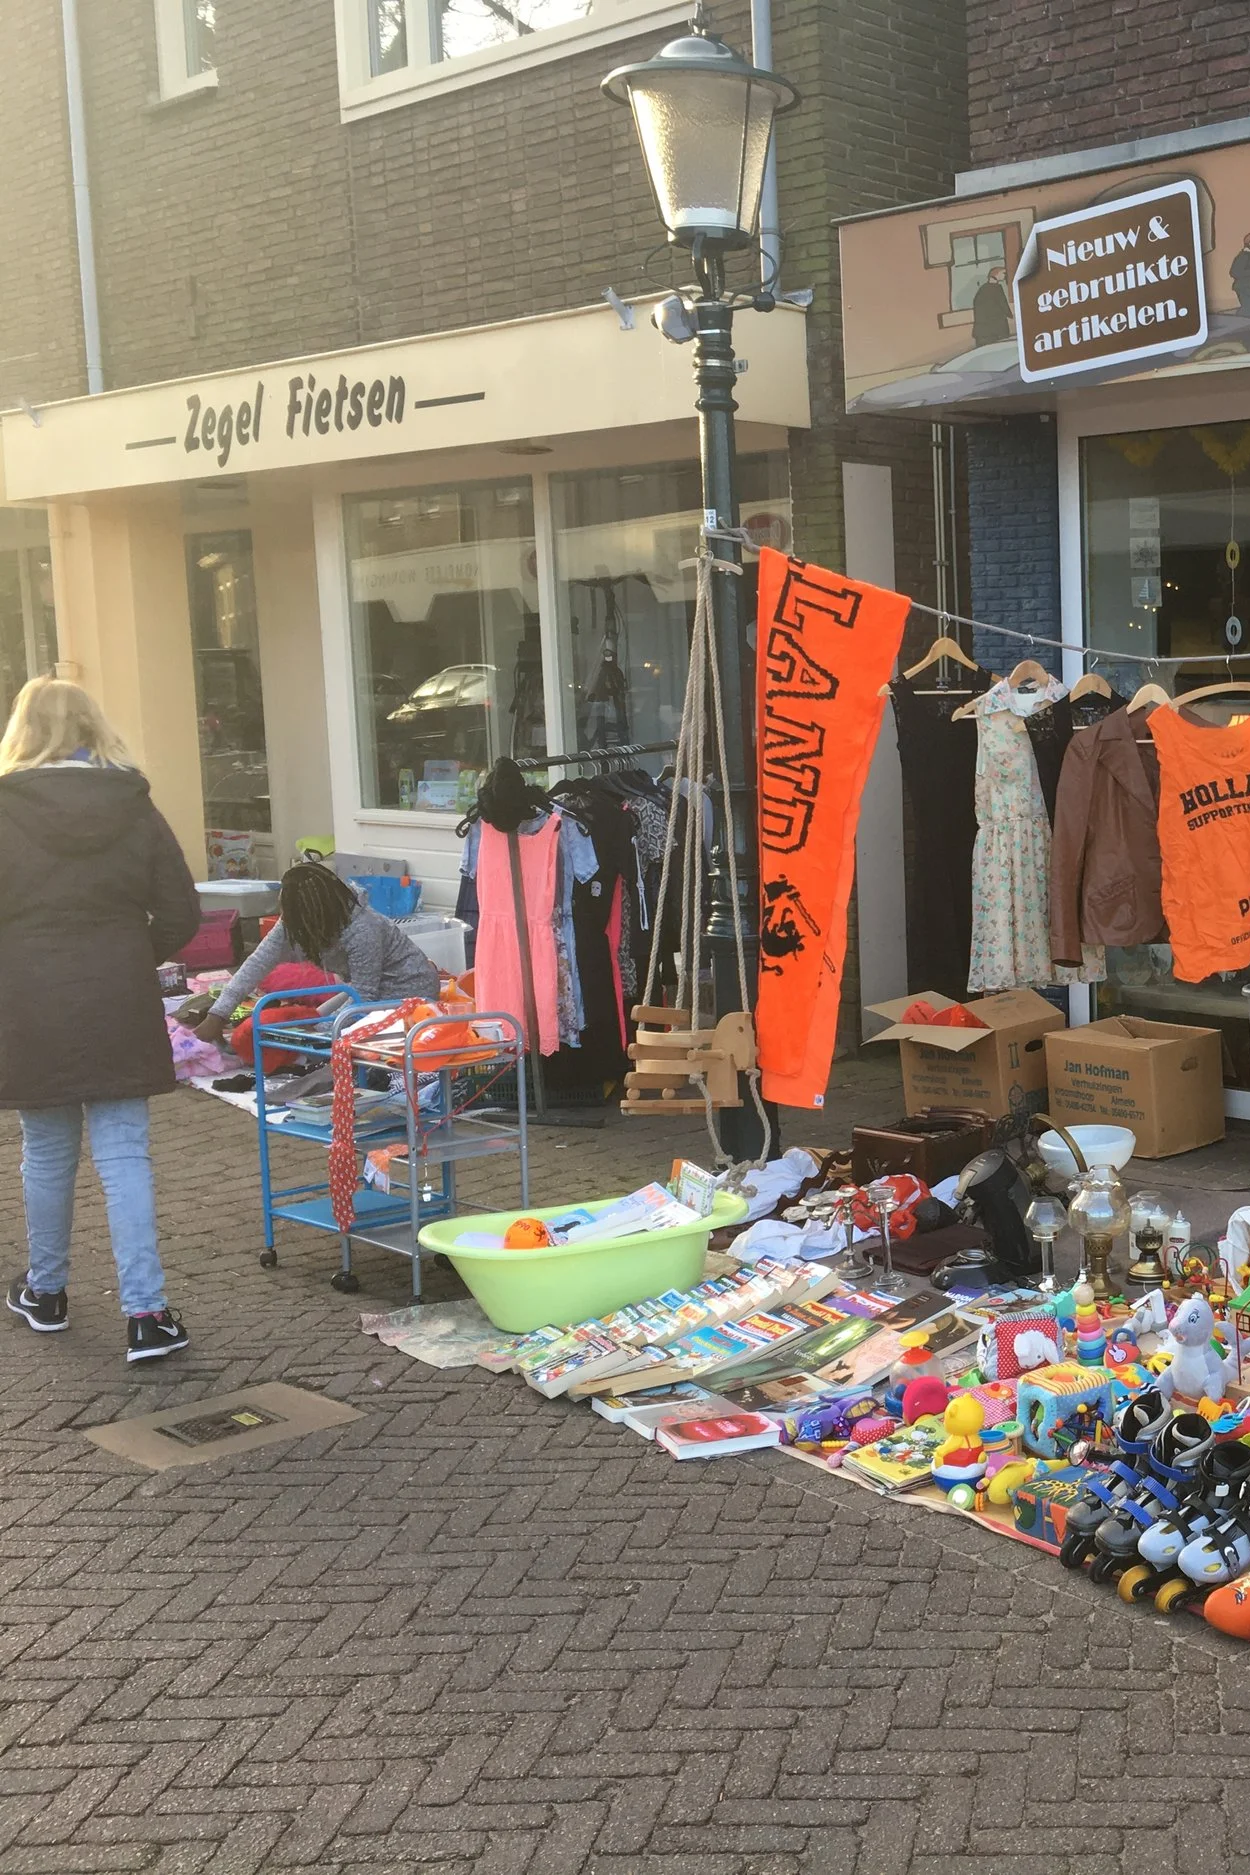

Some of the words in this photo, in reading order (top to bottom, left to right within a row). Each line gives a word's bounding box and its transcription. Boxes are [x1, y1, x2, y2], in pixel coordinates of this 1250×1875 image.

[1046, 225, 1141, 272] Nieuw
[1147, 215, 1170, 243] &
[1037, 254, 1189, 313] gebruikte
[1033, 299, 1189, 353] artikelen.
[184, 380, 264, 468] Zegel
[286, 373, 406, 439] Fietsen
[1063, 1060, 1082, 1074] Jan
[1085, 1063, 1130, 1081] Hofman
